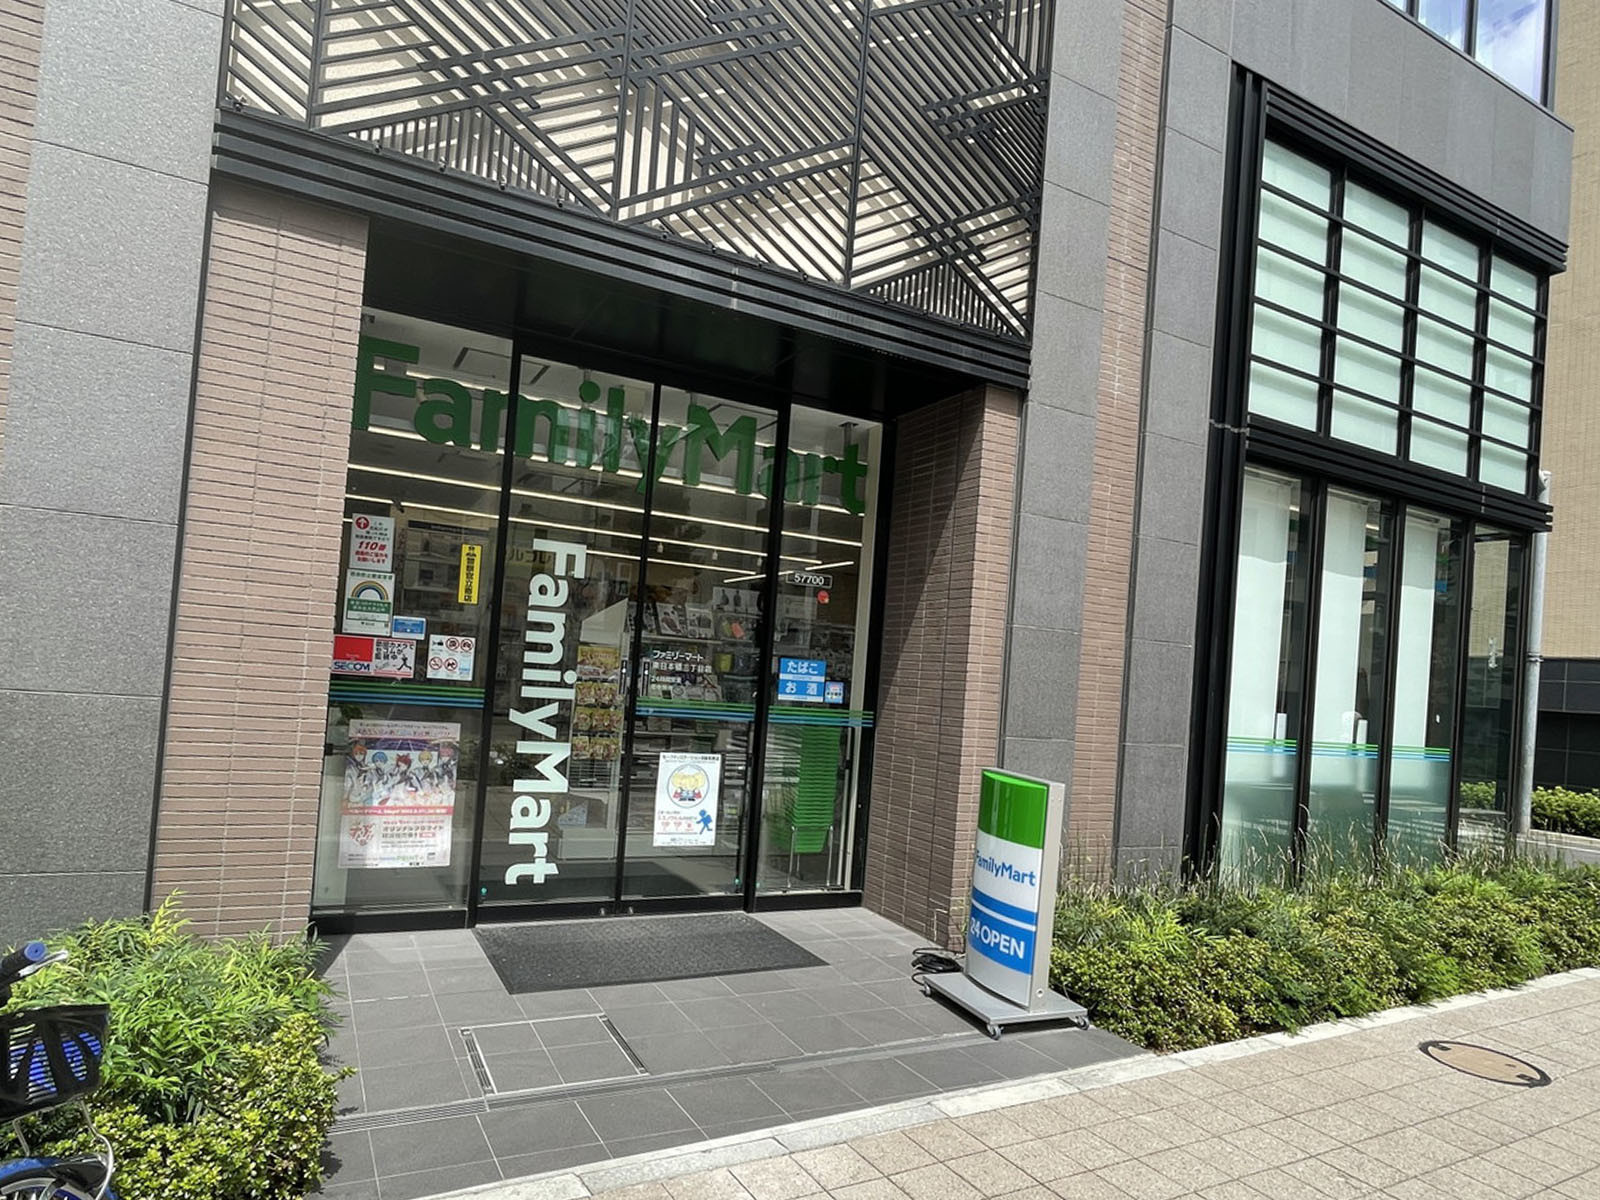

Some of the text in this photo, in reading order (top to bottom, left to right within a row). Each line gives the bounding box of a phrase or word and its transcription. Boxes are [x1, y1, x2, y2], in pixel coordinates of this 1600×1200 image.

[352, 336, 868, 514] FamilyMart
[794, 573, 825, 585] 57700
[652, 650, 704, 662] ファミリーマート
[334, 661, 370, 671] SECOM
[787, 661, 818, 674] たばこ
[504, 538, 587, 886] FamilyMart
[980, 925, 1025, 959] OPEN
